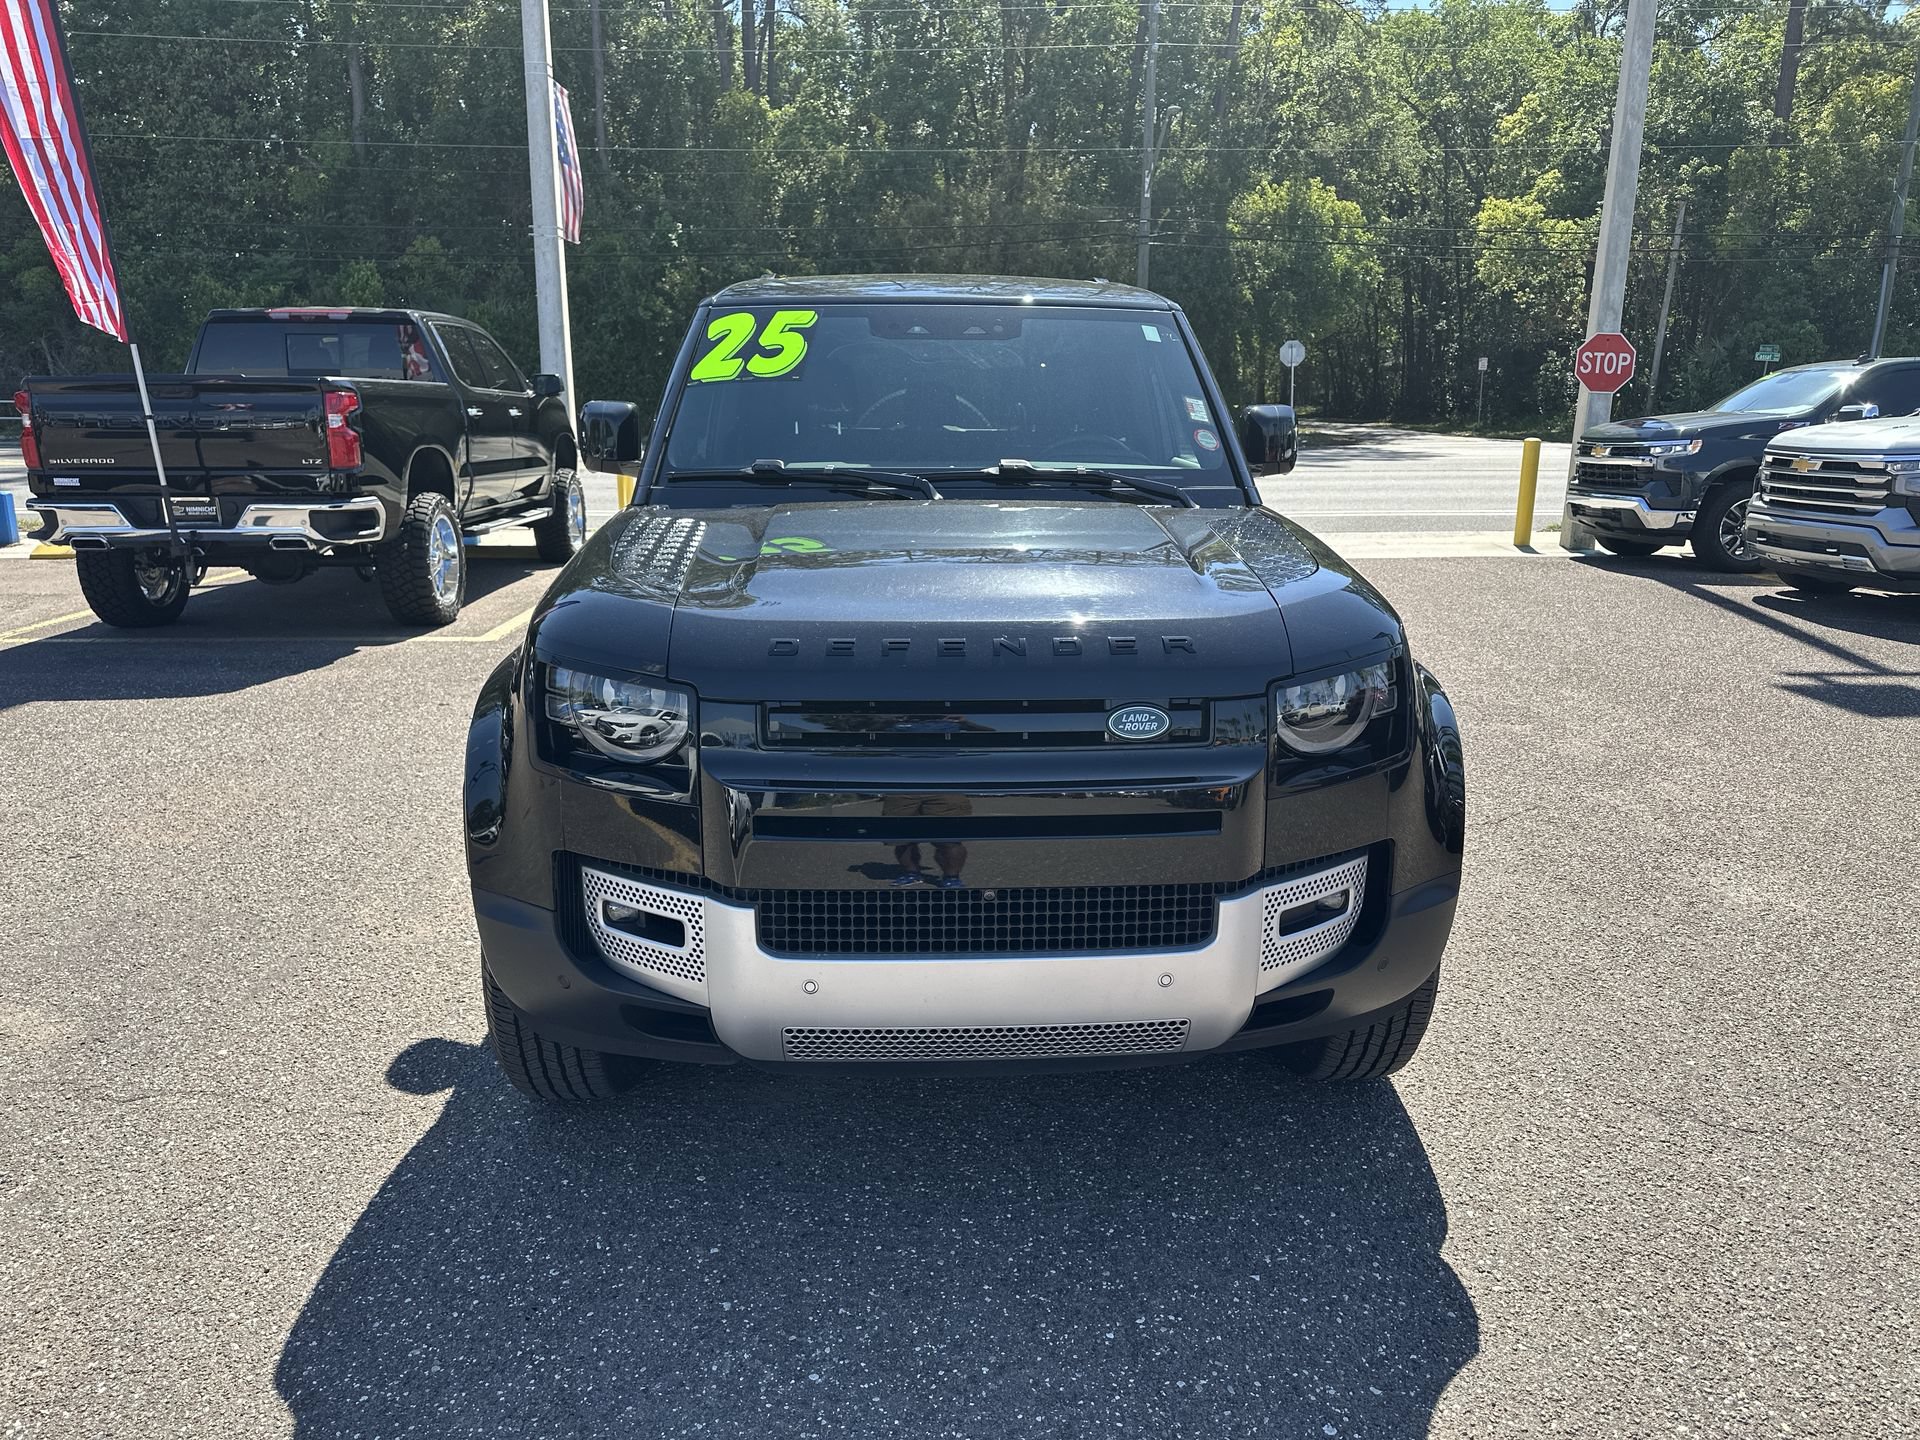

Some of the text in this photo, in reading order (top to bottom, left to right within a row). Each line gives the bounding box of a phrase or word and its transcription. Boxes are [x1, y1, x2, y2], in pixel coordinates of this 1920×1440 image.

[690, 310, 819, 383] 25
[1580, 351, 1631, 374] STOP
[767, 635, 1198, 657] DEFENDER
[1122, 713, 1150, 722] LAND
[1124, 722, 1158, 731] ROVER
